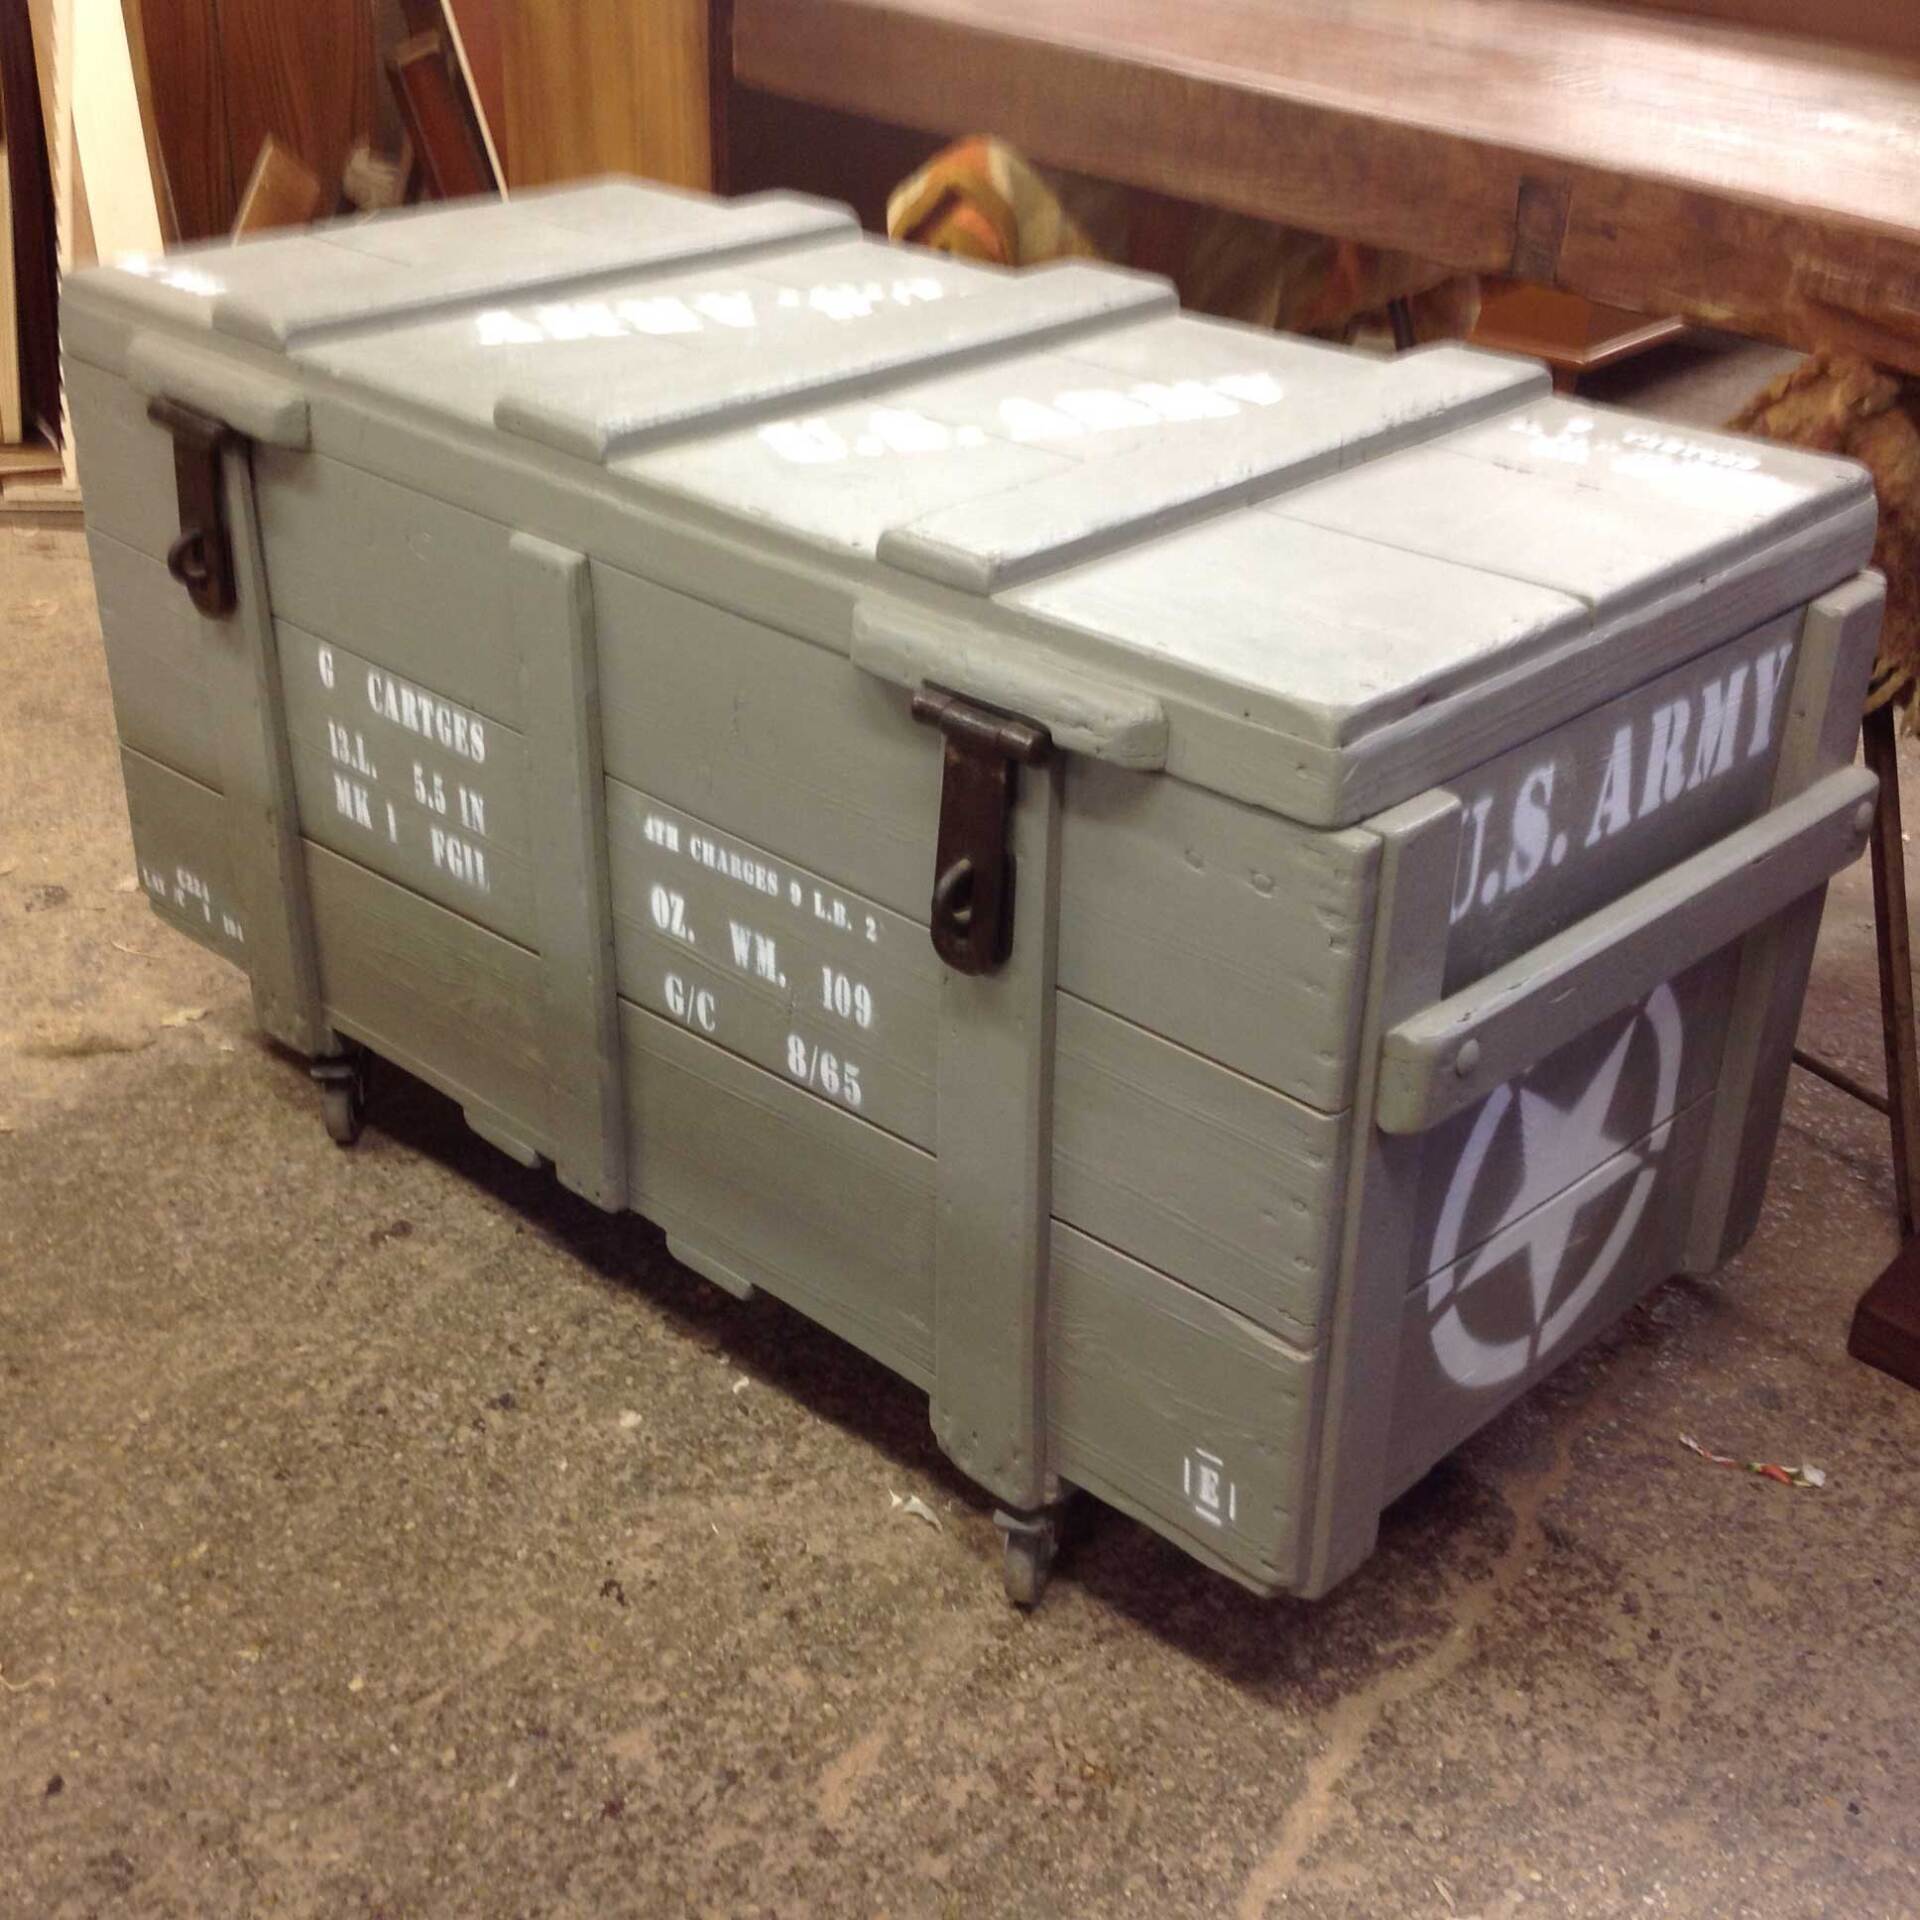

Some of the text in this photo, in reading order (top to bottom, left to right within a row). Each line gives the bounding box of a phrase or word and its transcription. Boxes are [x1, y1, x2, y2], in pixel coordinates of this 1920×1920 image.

[367, 672, 486, 764] CARTGES
[1584, 642, 1793, 849] ARMY
[334, 773, 373, 830] MK
[459, 785, 486, 836] IN
[690, 835, 779, 897] CHARGES
[822, 965, 872, 1029] 109
[664, 972, 862, 1106] G/C 8/65
